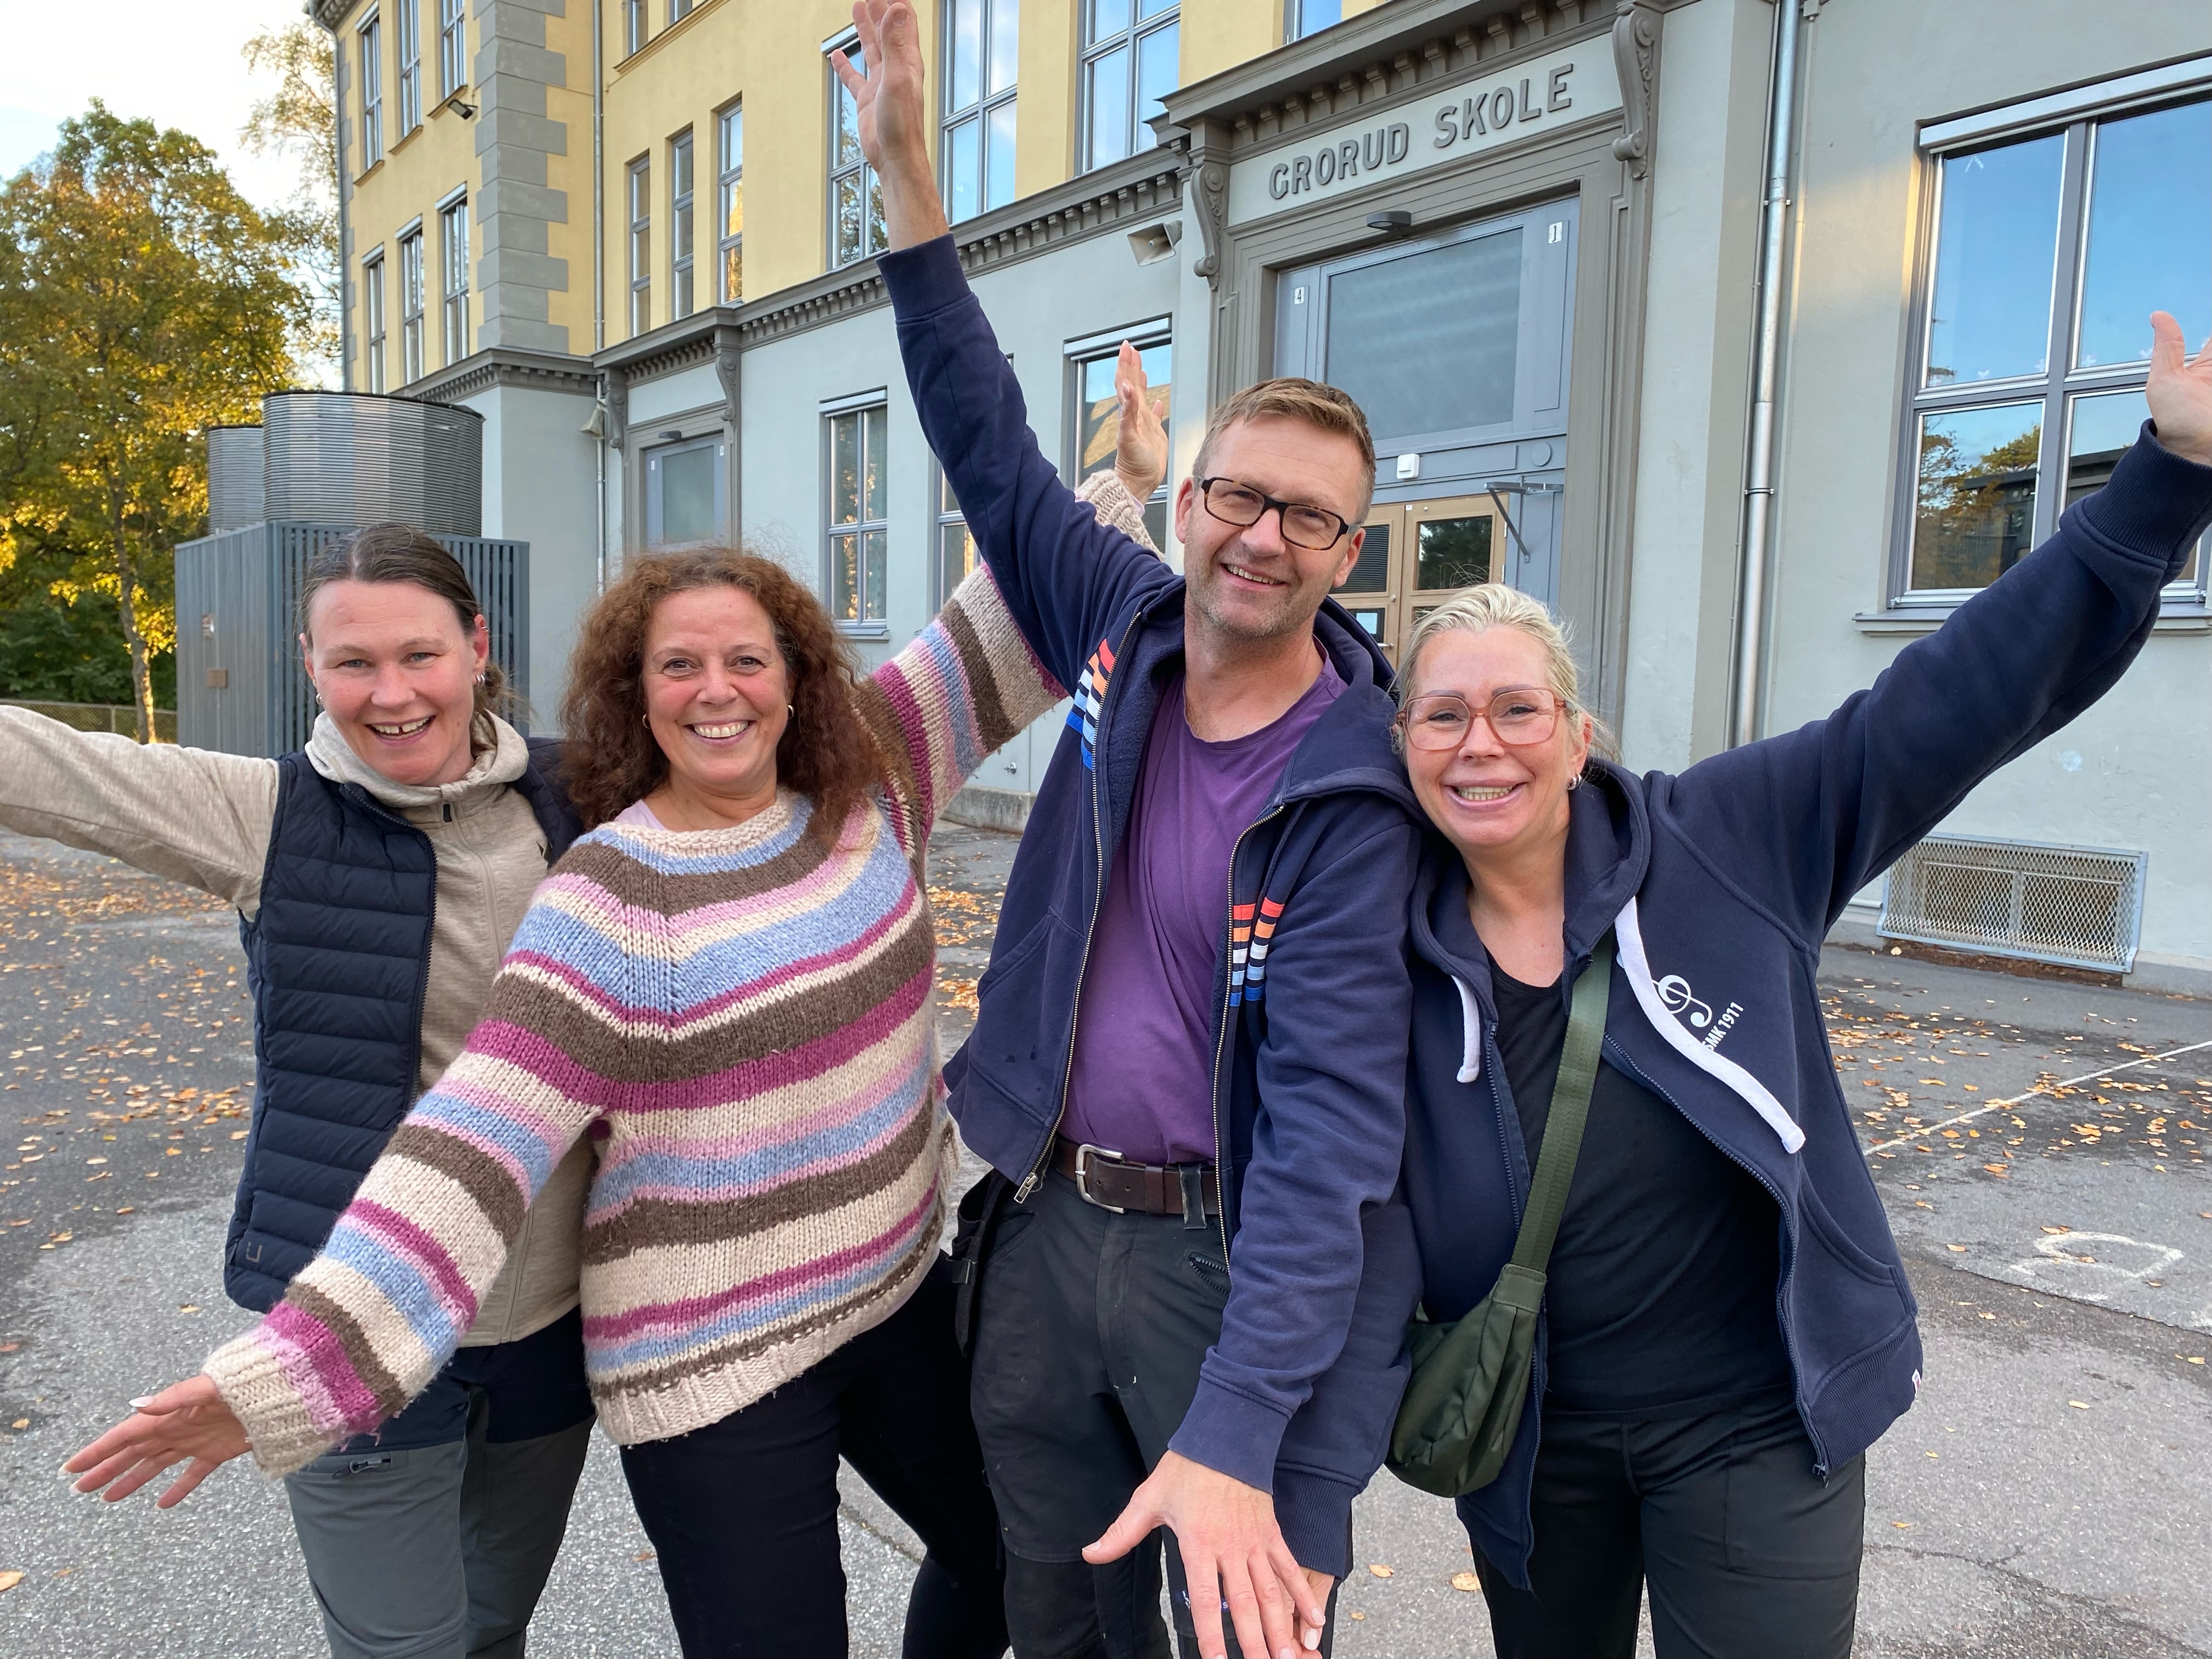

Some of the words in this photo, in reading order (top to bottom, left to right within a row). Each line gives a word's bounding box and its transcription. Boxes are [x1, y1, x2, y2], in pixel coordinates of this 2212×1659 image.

[1269, 122, 1409, 200] GRORUD
[1433, 63, 1574, 148] SKOLE
[1296, 288, 1302, 303] 4
[1718, 1002, 1744, 1029] 1911
